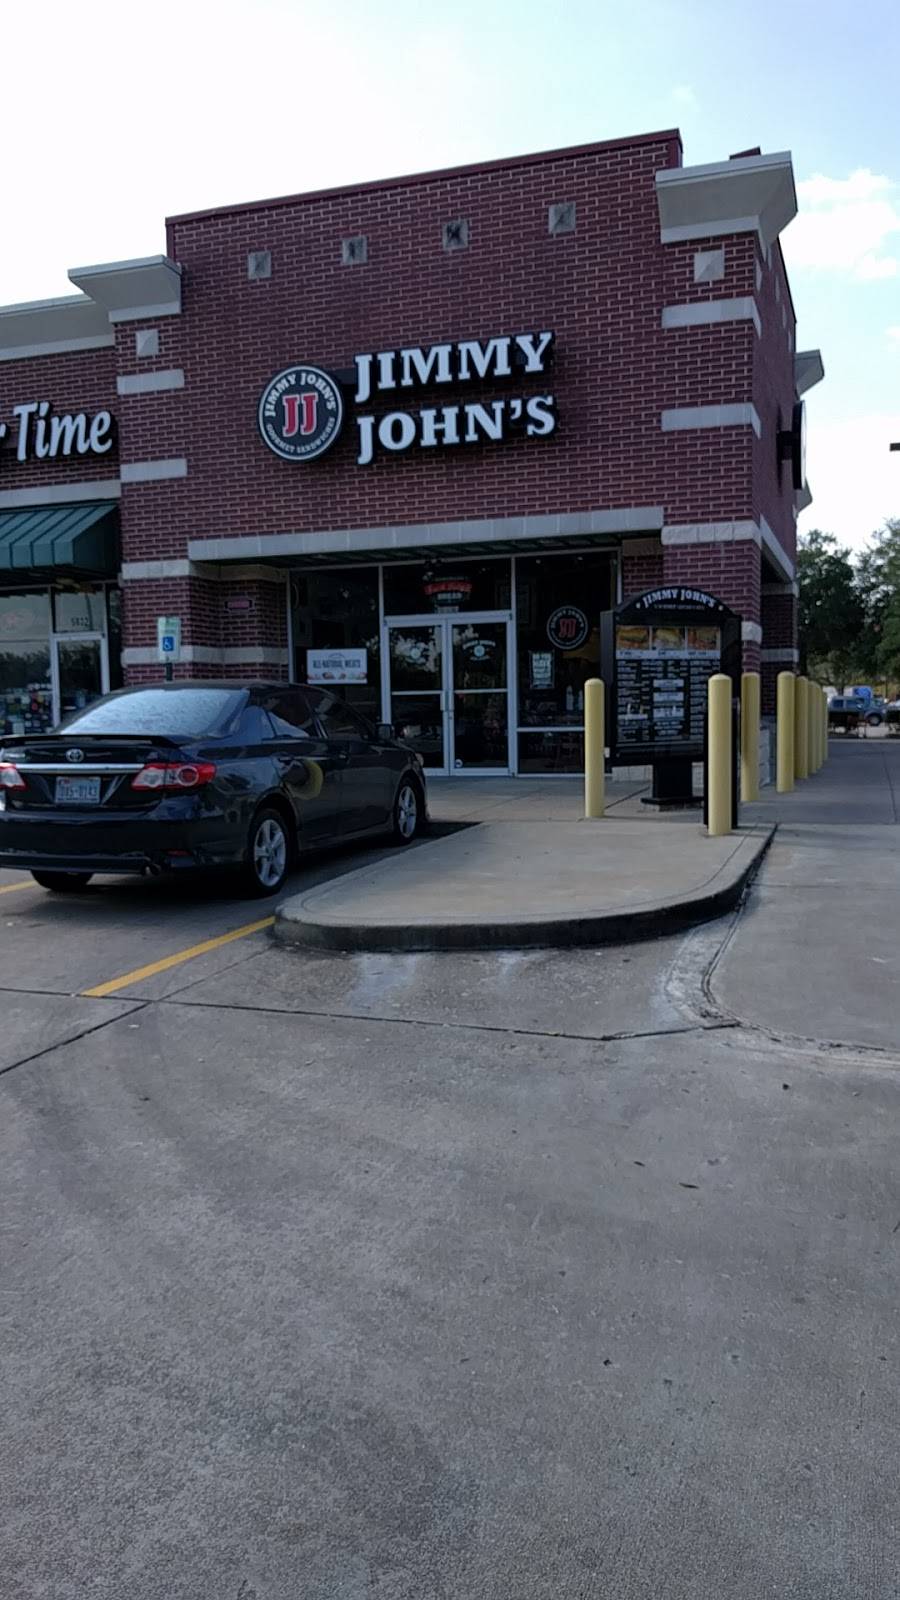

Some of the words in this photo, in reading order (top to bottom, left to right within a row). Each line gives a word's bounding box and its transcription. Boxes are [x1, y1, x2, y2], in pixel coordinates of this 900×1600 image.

[264, 373, 296, 417] JIMMY
[300, 372, 337, 411] JOHN'S
[354, 332, 552, 403] JIMMY
[13, 401, 113, 462] Time
[282, 391, 319, 438] JJ
[356, 395, 555, 465] JOHN'S
[642, 588, 679, 608] JIMMY
[680, 589, 717, 608] JOHN'S
